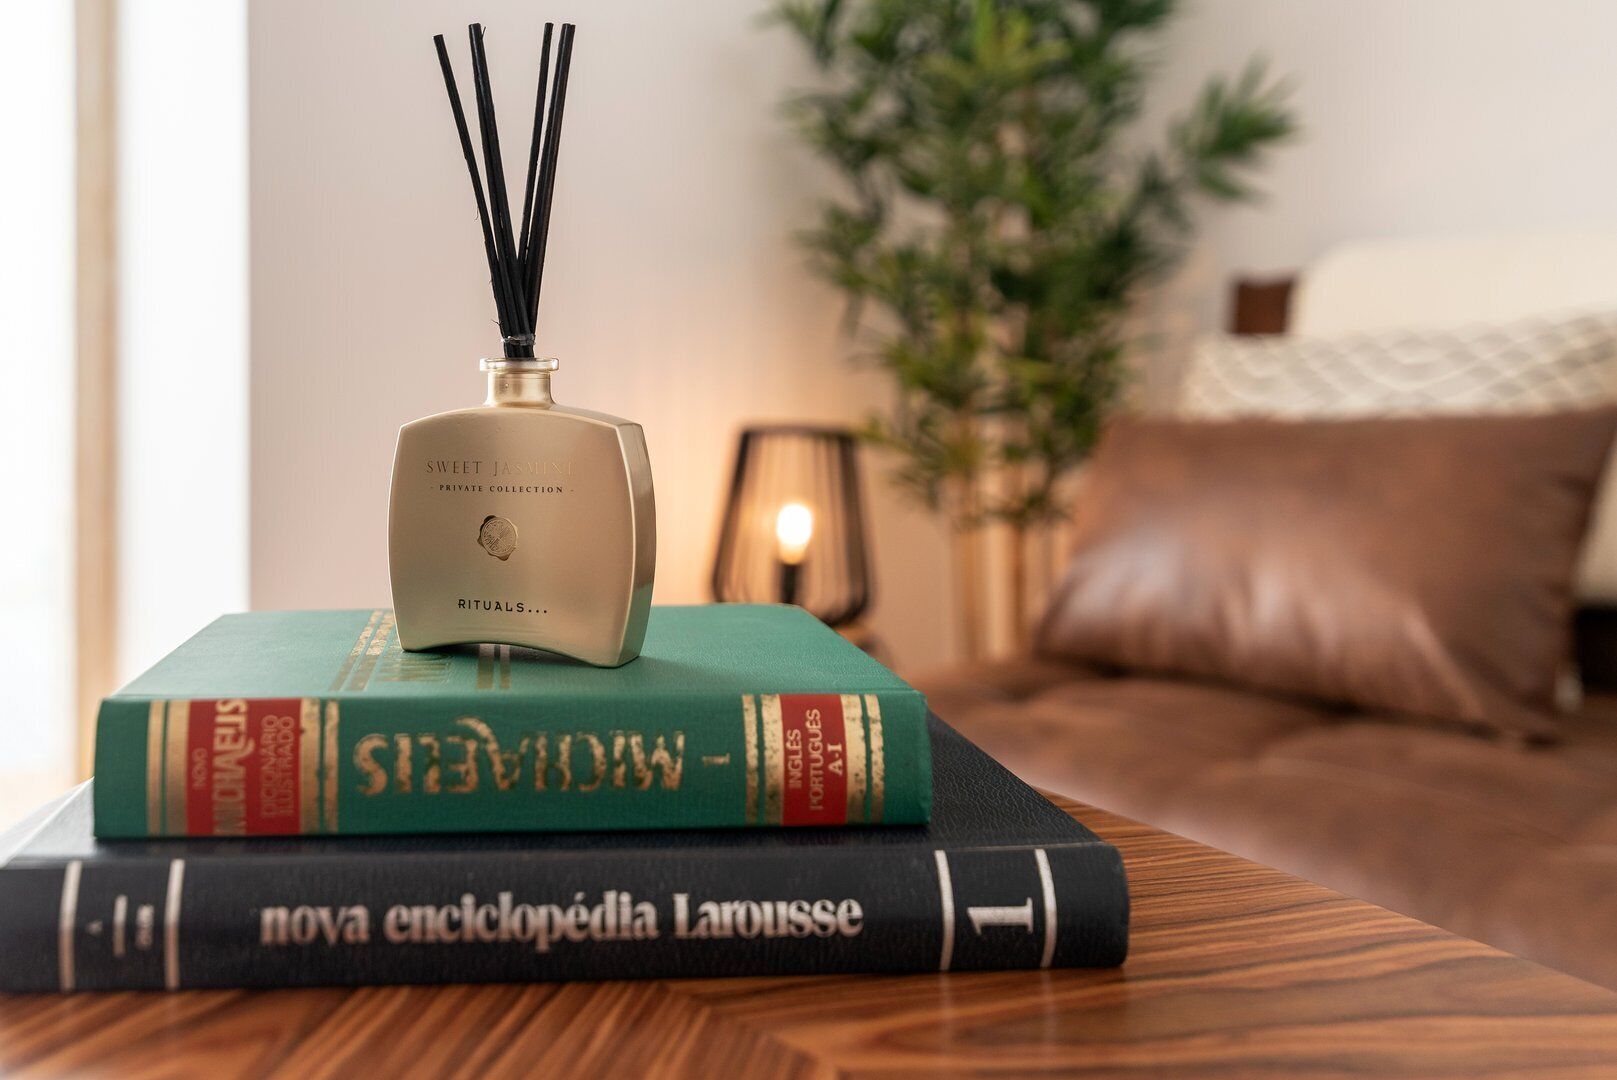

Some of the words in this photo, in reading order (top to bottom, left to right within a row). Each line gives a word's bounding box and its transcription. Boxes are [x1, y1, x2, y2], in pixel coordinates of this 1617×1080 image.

[426, 460, 483, 475] SWEET
[439, 484, 483, 492] PRIVATE
[489, 485, 564, 493] COLLECTION
[191, 747, 209, 790] NOVO
[259, 904, 371, 947] nova
[383, 890, 659, 953] enciclopédia
[671, 892, 865, 940] Larousse
[966, 896, 1034, 936] 1
